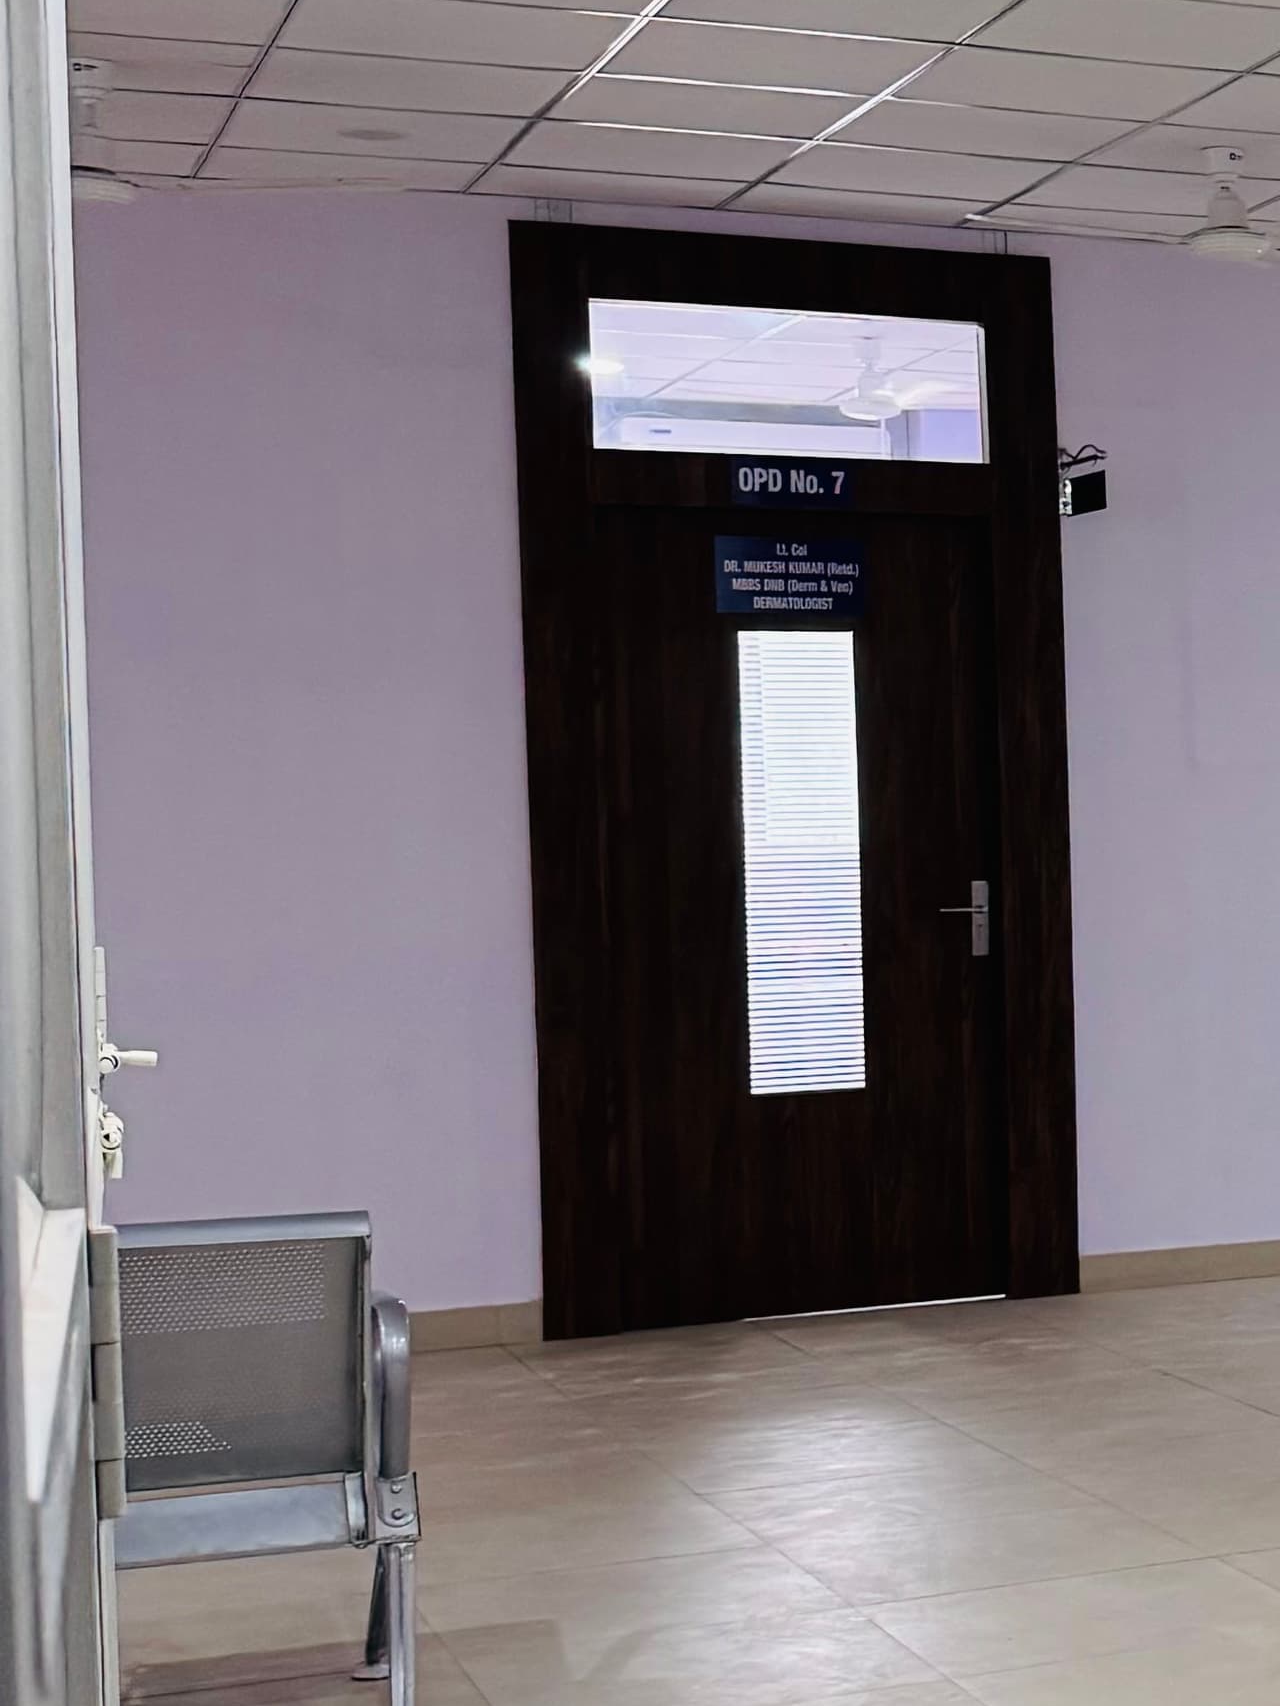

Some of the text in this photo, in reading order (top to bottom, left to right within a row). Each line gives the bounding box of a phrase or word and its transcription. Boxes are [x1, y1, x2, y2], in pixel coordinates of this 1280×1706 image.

[738, 467, 845, 495] OPD No. 7
[791, 544, 808, 556] Col
[723, 560, 741, 573] DR.
[743, 561, 786, 574] MUKESH
[789, 562, 825, 575] KUMAR
[732, 578, 761, 591] MBBS
[820, 580, 828, 592] &
[753, 597, 834, 611] DERMATOLOGIST
